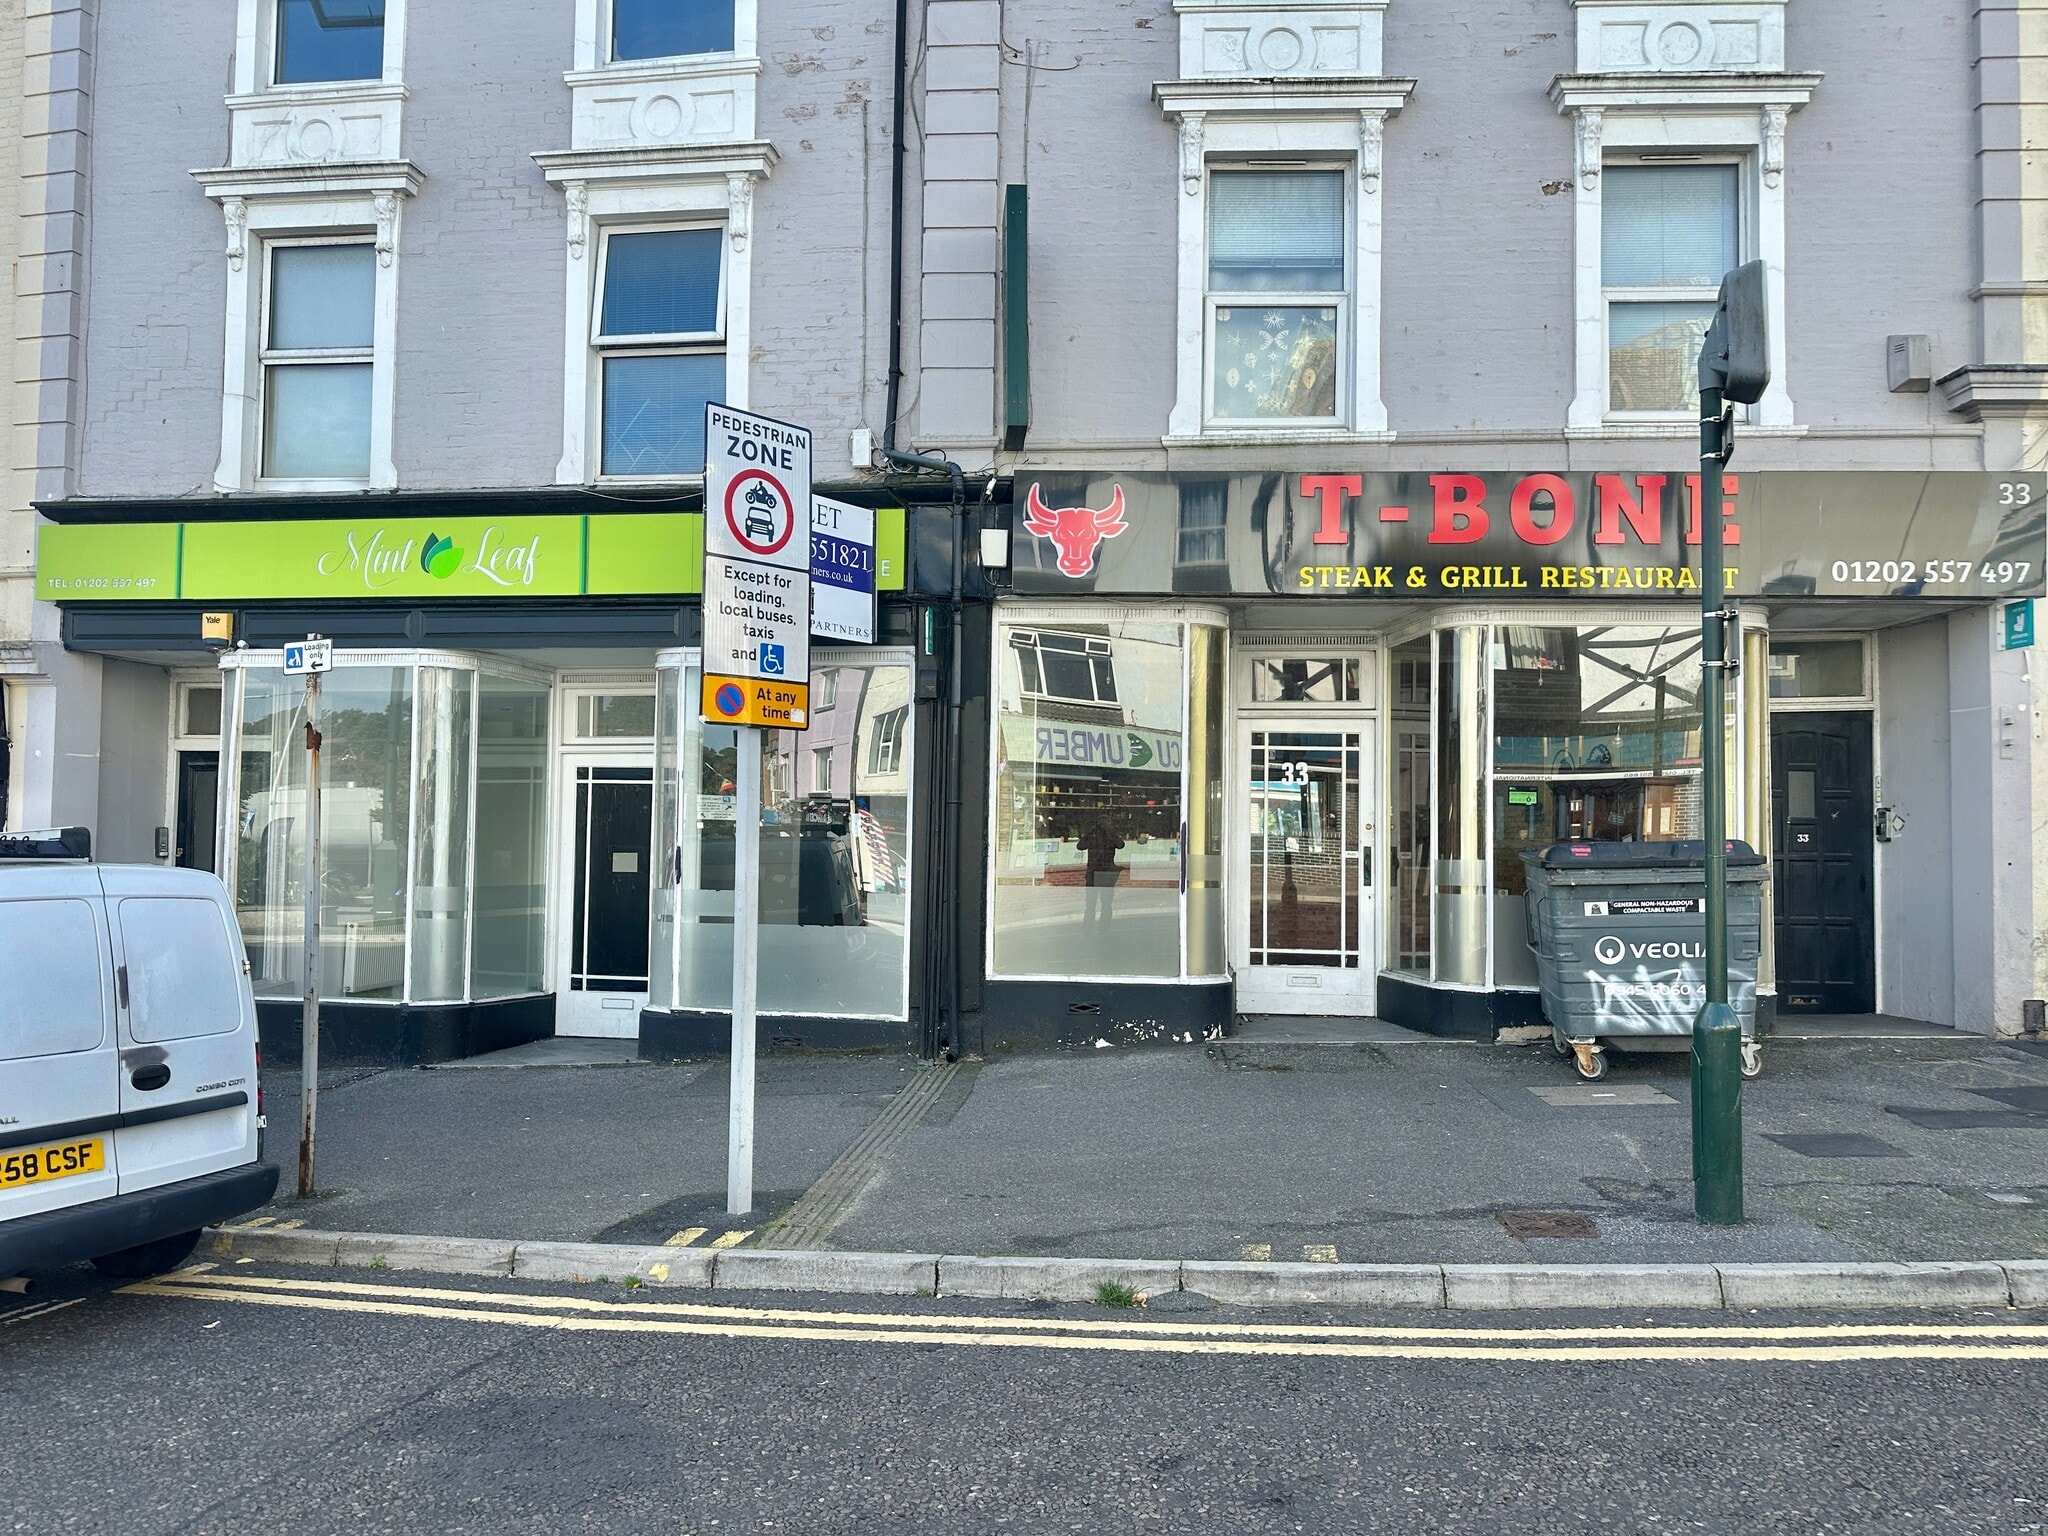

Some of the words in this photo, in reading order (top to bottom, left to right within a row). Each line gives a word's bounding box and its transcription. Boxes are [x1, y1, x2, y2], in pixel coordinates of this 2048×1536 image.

[712, 412, 806, 450] PEDESTRIAN
[727, 434, 793, 471] ZONE
[1999, 483, 2031, 505] 33
[811, 503, 842, 530] ET
[317, 528, 418, 590] Mint
[462, 525, 543, 586] Leaf
[48, 579, 71, 588] TEL:
[75, 578, 109, 588] 01202
[112, 579, 132, 588] 557
[136, 578, 156, 588] 497
[724, 565, 770, 586] Except
[773, 574, 792, 589] for
[1299, 566, 1394, 588] STEAK
[1405, 566, 1427, 588] &
[1440, 566, 1528, 588] GRILL
[1540, 566, 1739, 589] RESTAURAT
[1831, 560, 1917, 584] 01202
[1923, 560, 1973, 584] 557
[1980, 561, 2031, 584] 497
[734, 585, 785, 608] loading,
[205, 616, 221, 624] Yale
[719, 600, 753, 618] local
[757, 606, 797, 626] buses,
[743, 622, 775, 640] taxis
[304, 642, 329, 653] Loading
[309, 651, 324, 660] only
[731, 648, 757, 661] and
[757, 687, 772, 701] At
[775, 692, 797, 706] any
[762, 705, 790, 720] time
[1281, 762, 1309, 786] 33
[1797, 834, 1810, 843] 33
[1629, 942, 1706, 959] VEOLI
[0, 1153, 38, 1182] 58
[46, 1143, 93, 1174] CSF
